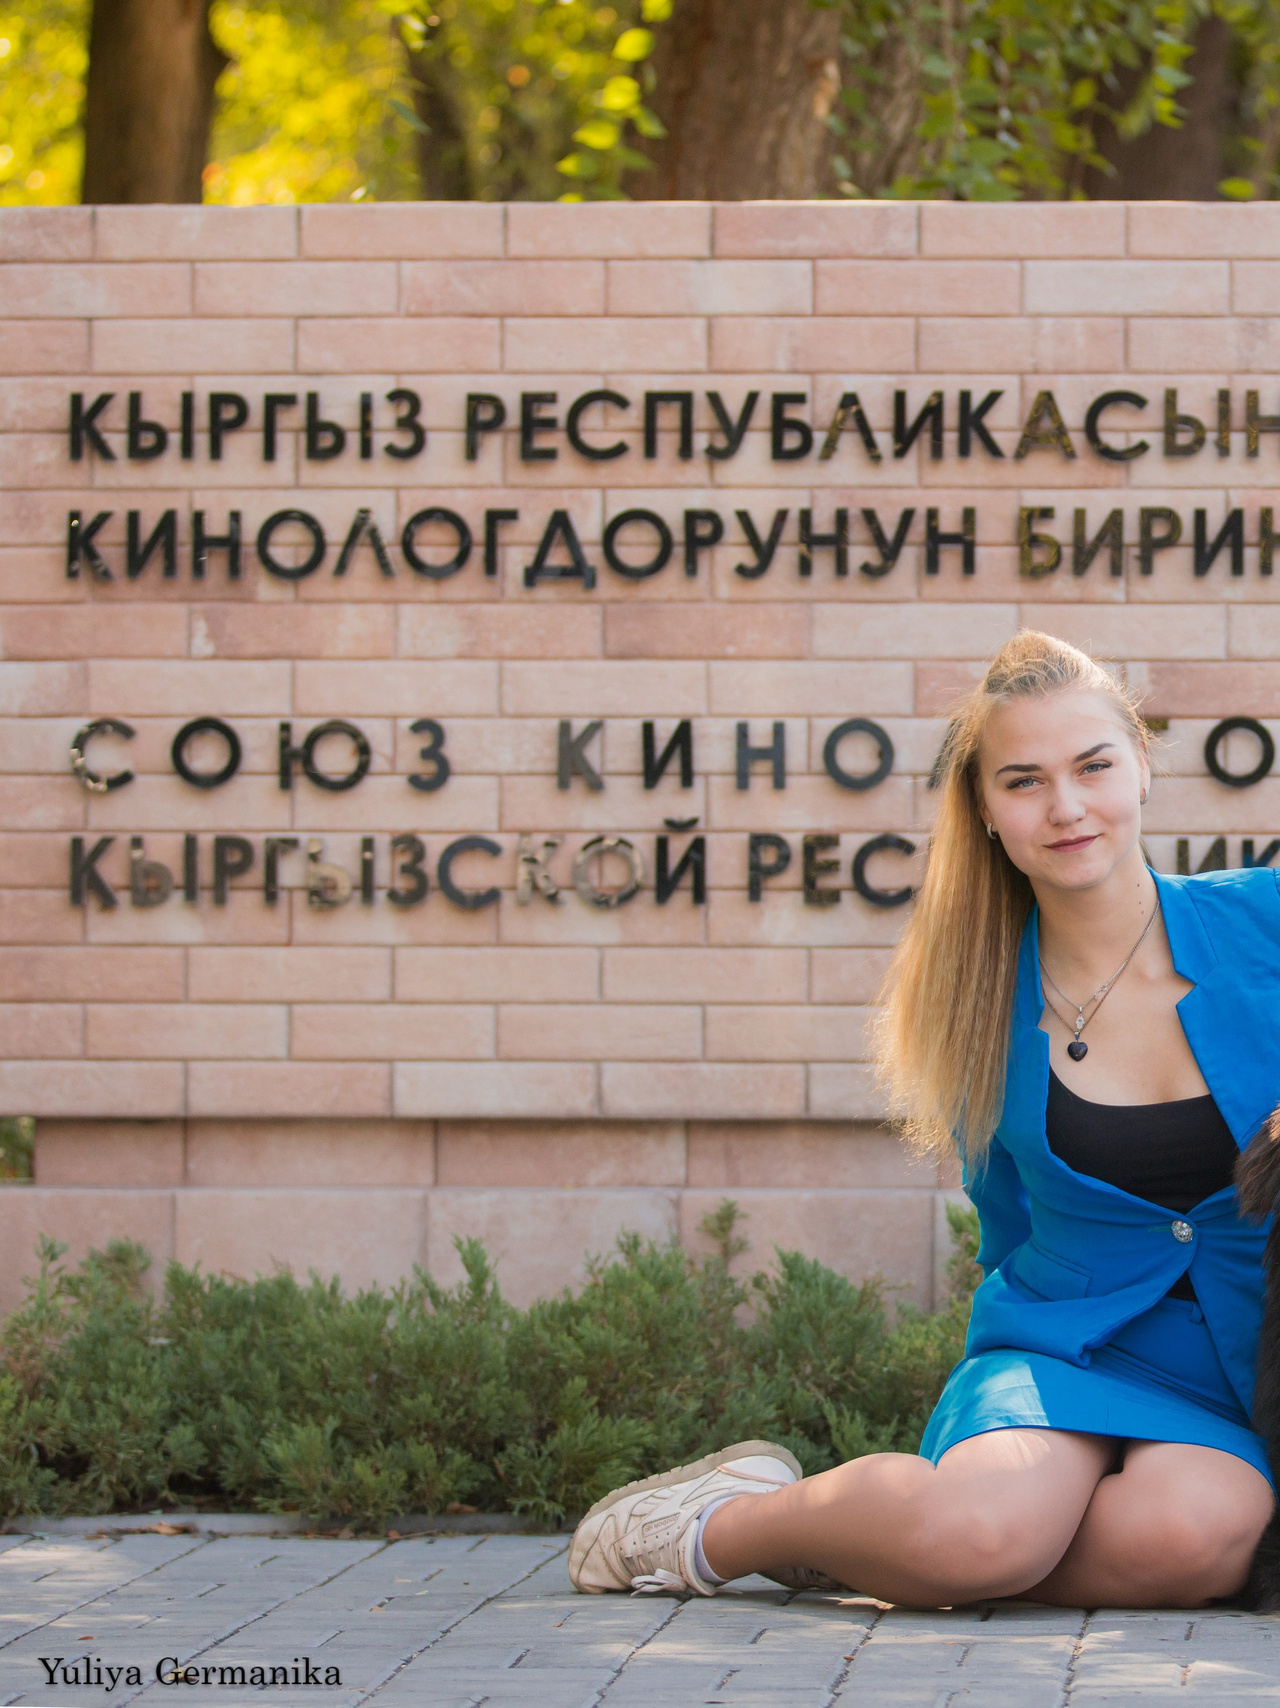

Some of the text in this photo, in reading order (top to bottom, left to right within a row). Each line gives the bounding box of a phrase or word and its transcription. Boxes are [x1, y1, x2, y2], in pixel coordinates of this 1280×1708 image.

[68, 388, 426, 461] КЫРГЫЗ
[66, 507, 977, 589] КИНОЛОГДОРУНУН
[70, 716, 451, 793] СОЮЗ
[68, 817, 706, 910] КЫРГЫЗСКОЙ
